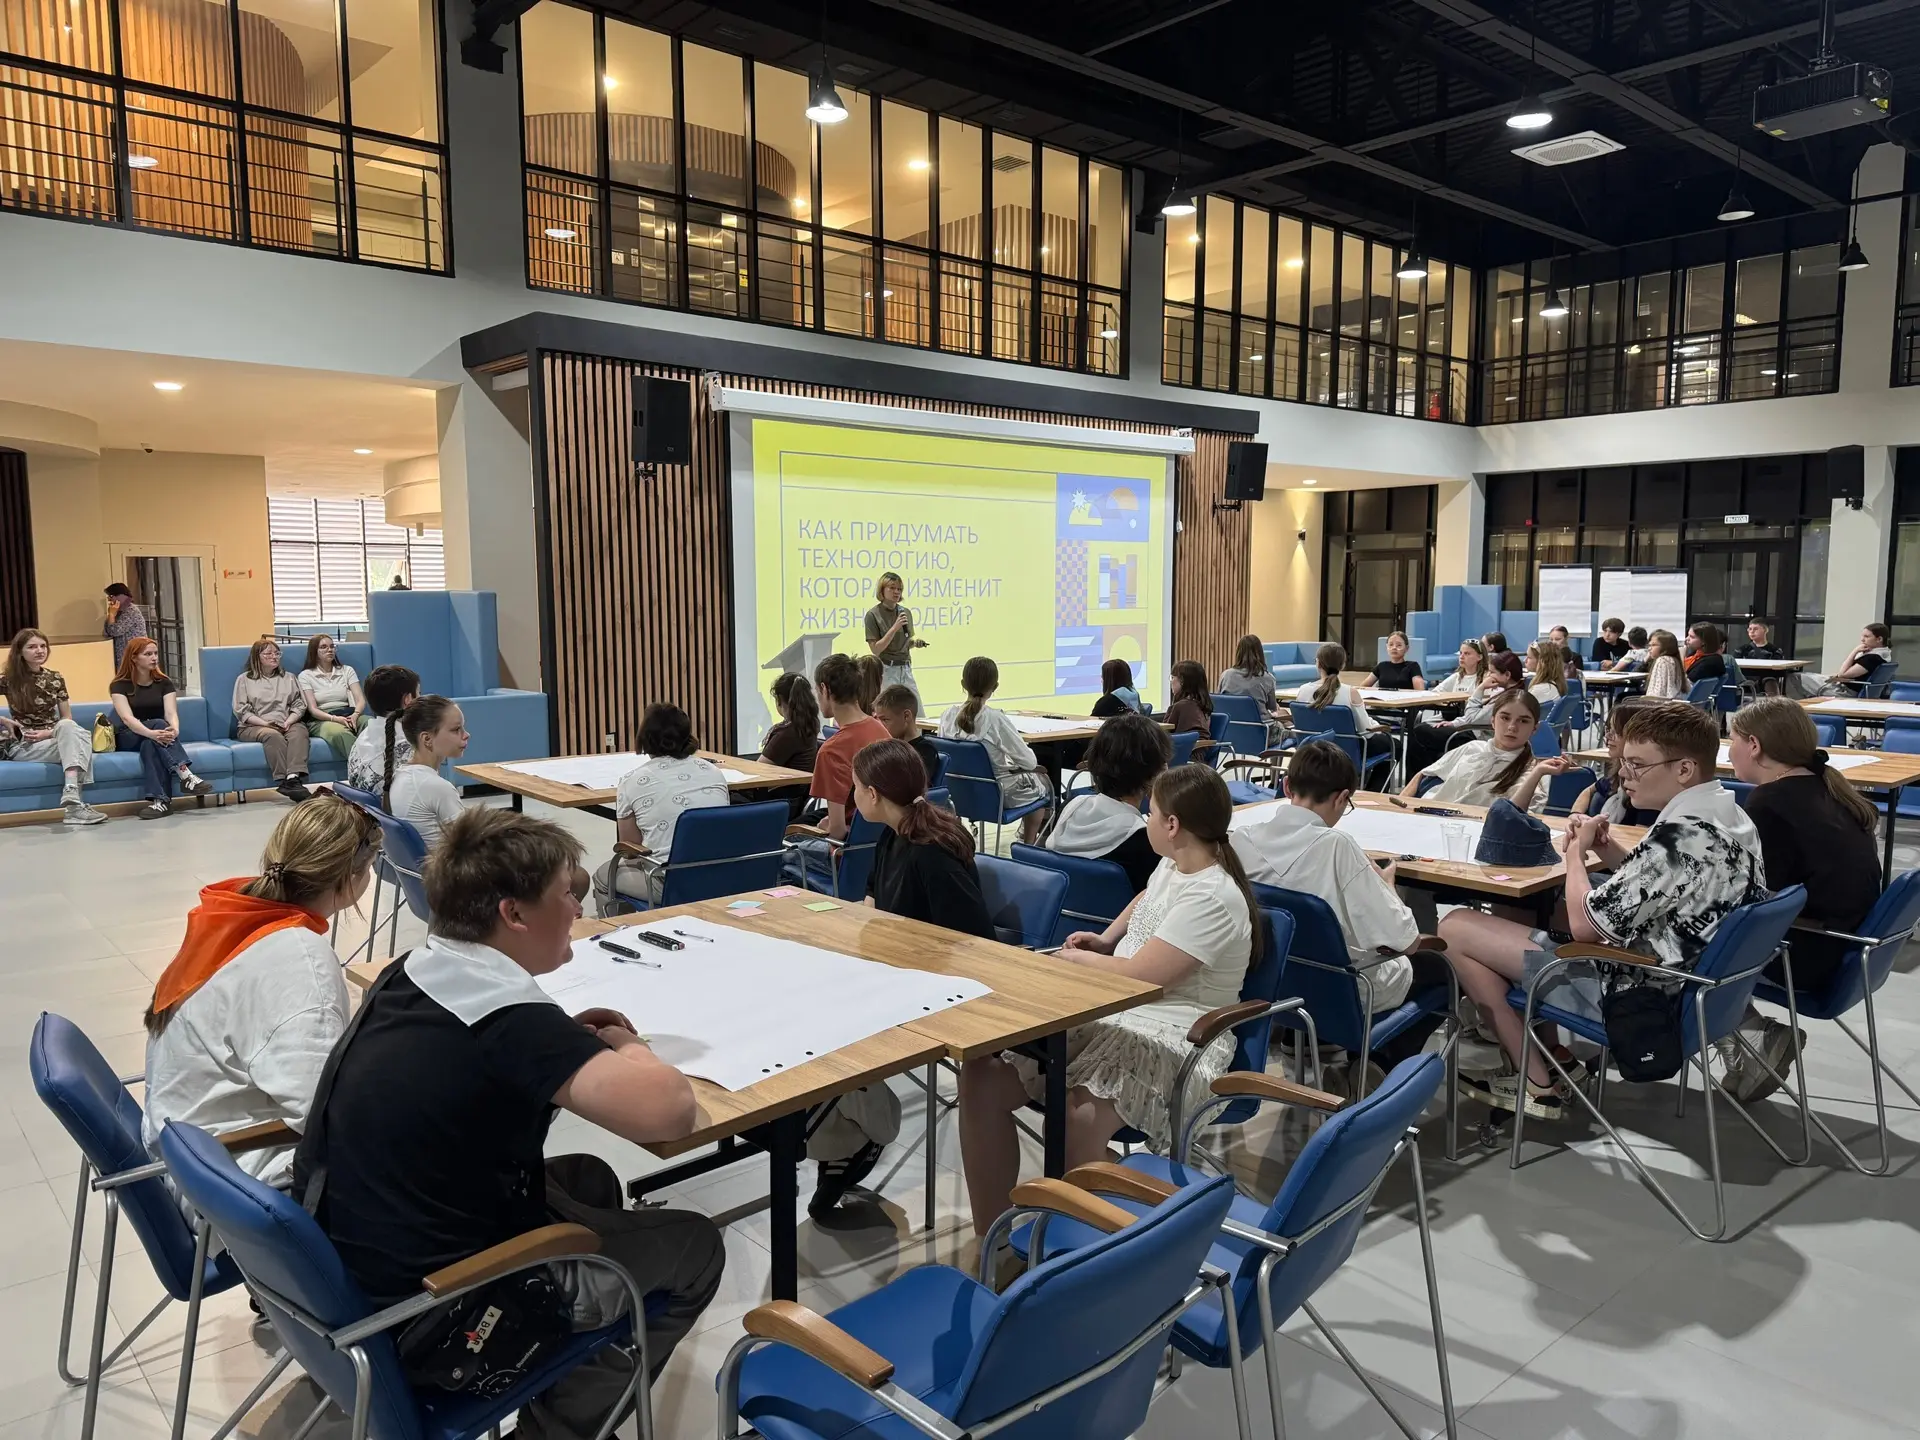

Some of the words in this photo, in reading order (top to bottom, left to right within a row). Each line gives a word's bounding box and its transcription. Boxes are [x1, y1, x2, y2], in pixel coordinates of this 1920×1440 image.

[799, 519, 842, 540] КАК
[850, 521, 979, 546] ПРИДУМАТЬ
[798, 548, 955, 573] ТЕХНОЛОГИЮ,
[800, 577, 877, 598] КОТОР
[907, 577, 1002, 598] ИЗМЕНИТ
[800, 607, 865, 629] ЖИЗН
[472, 1321, 491, 1346] BEAR
